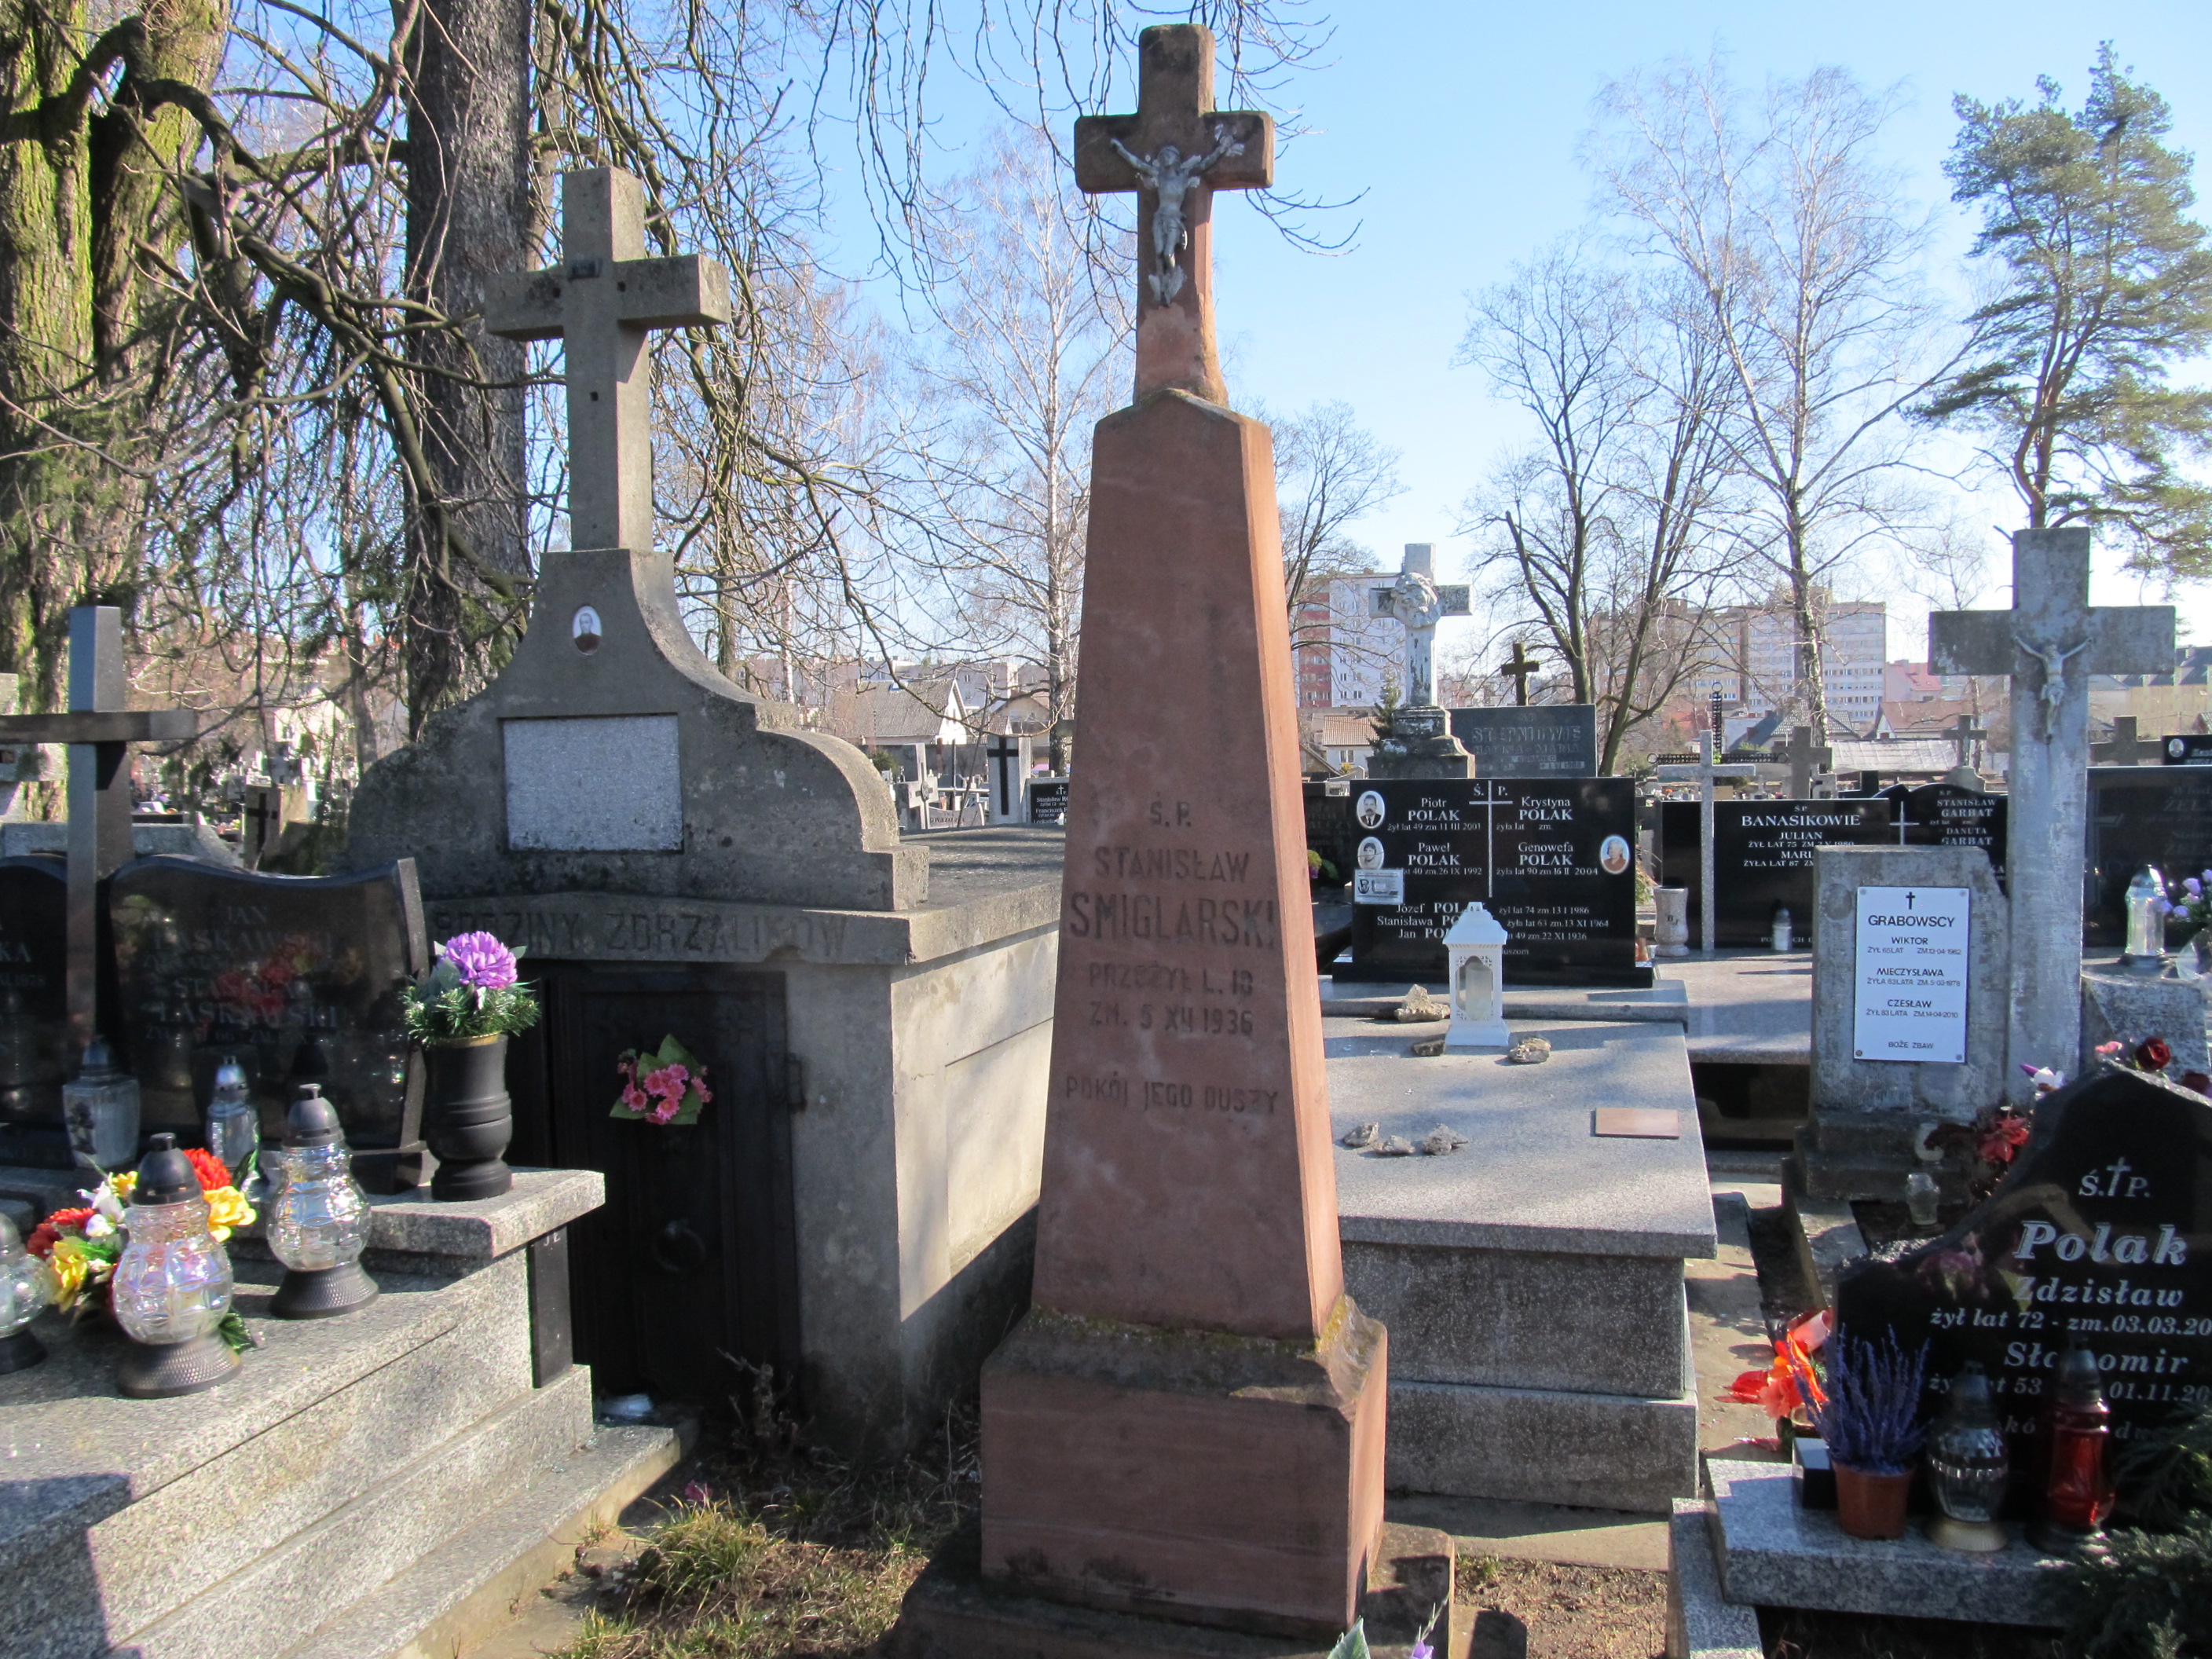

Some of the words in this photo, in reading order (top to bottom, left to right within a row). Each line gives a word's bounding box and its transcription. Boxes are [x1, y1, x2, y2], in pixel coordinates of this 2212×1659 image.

[1421, 797, 1447, 808] Piotr
[1522, 796, 1571, 809] Krystyna
[1408, 809, 1461, 822] POLAK
[1518, 808, 1573, 821] POLAK
[1941, 808, 1994, 818] GARBAT
[1741, 815, 1861, 826] BANASIKOWIE
[1779, 831, 1823, 840] JULIAN
[1941, 837, 1994, 845] GARBAT
[1418, 842, 1450, 852] Paweł
[1518, 841, 1574, 852] Genowefa
[1408, 854, 1462, 866] POLAK
[1519, 854, 1573, 866] POLAK
[1781, 851, 1814, 859] MARI
[1094, 845, 1251, 884] STANISŁAW
[1463, 867, 1482, 876] 1992
[1396, 903, 1425, 914] Józef
[1376, 915, 1434, 926] Stanisława
[1525, 919, 1536, 928] lat
[1868, 914, 1955, 928] GRABOWSCY
[1398, 928, 1416, 939] Jan
[1568, 932, 1588, 940] 1936
[1891, 936, 1929, 945] WIKTOR
[1501, 947, 1529, 955] uszom
[1876, 968, 1945, 976] MIECZYSŁAWA
[1202, 968, 1224, 994] L.
[1866, 976, 1886, 985] ŻYŁA
[1887, 998, 1932, 1009] CZESŁAW
[1089, 1000, 1129, 1027] ZM.
[1140, 1003, 1153, 1030] 5
[1203, 1006, 1254, 1037] 1936
[1888, 1039, 1909, 1049] BOŻE
[1912, 1041, 1934, 1049] ZBAW
[1065, 1071, 1129, 1111] POKÓJ
[1143, 1081, 1193, 1111] JEGO
[1203, 1083, 1280, 1115] DUSZY
[2078, 1169, 2105, 1198] Ś.
[2124, 1176, 2152, 1199] P.
[2012, 1219, 2188, 1266] Polak
[2012, 1276, 2185, 1308] Zdzisław
[1929, 1307, 1966, 1330] żył
[1972, 1309, 2009, 1328] lat
[2017, 1311, 2045, 1328] 72
[2013, 1377, 2042, 1394] 53
